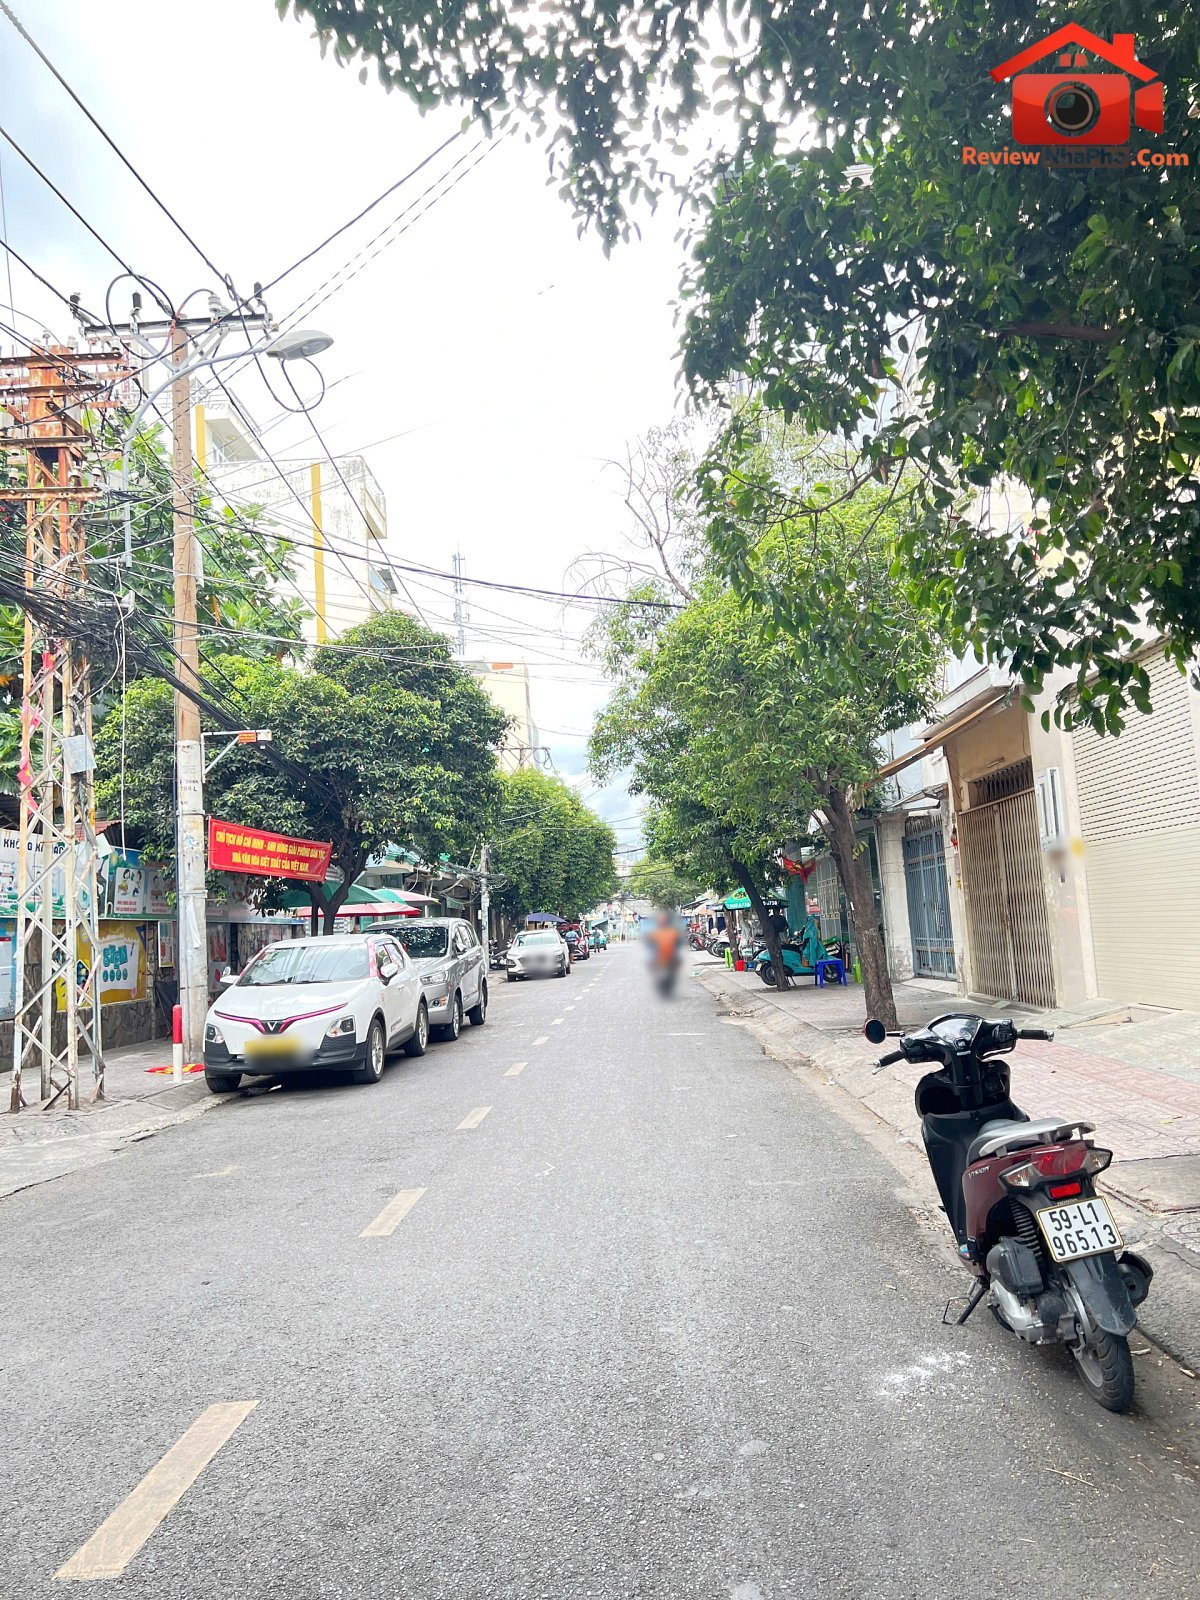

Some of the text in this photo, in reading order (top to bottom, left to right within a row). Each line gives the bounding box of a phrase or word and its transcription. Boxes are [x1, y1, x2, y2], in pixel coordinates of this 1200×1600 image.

[215, 829, 225, 843] CHỦ
[226, 832, 236, 847] TỊCH
[235, 832, 244, 846] HỒ
[243, 835, 252, 848] CHÍ
[1048, 1202, 1100, 1231] 59-L1
[1052, 1223, 1117, 1257] 965.13
